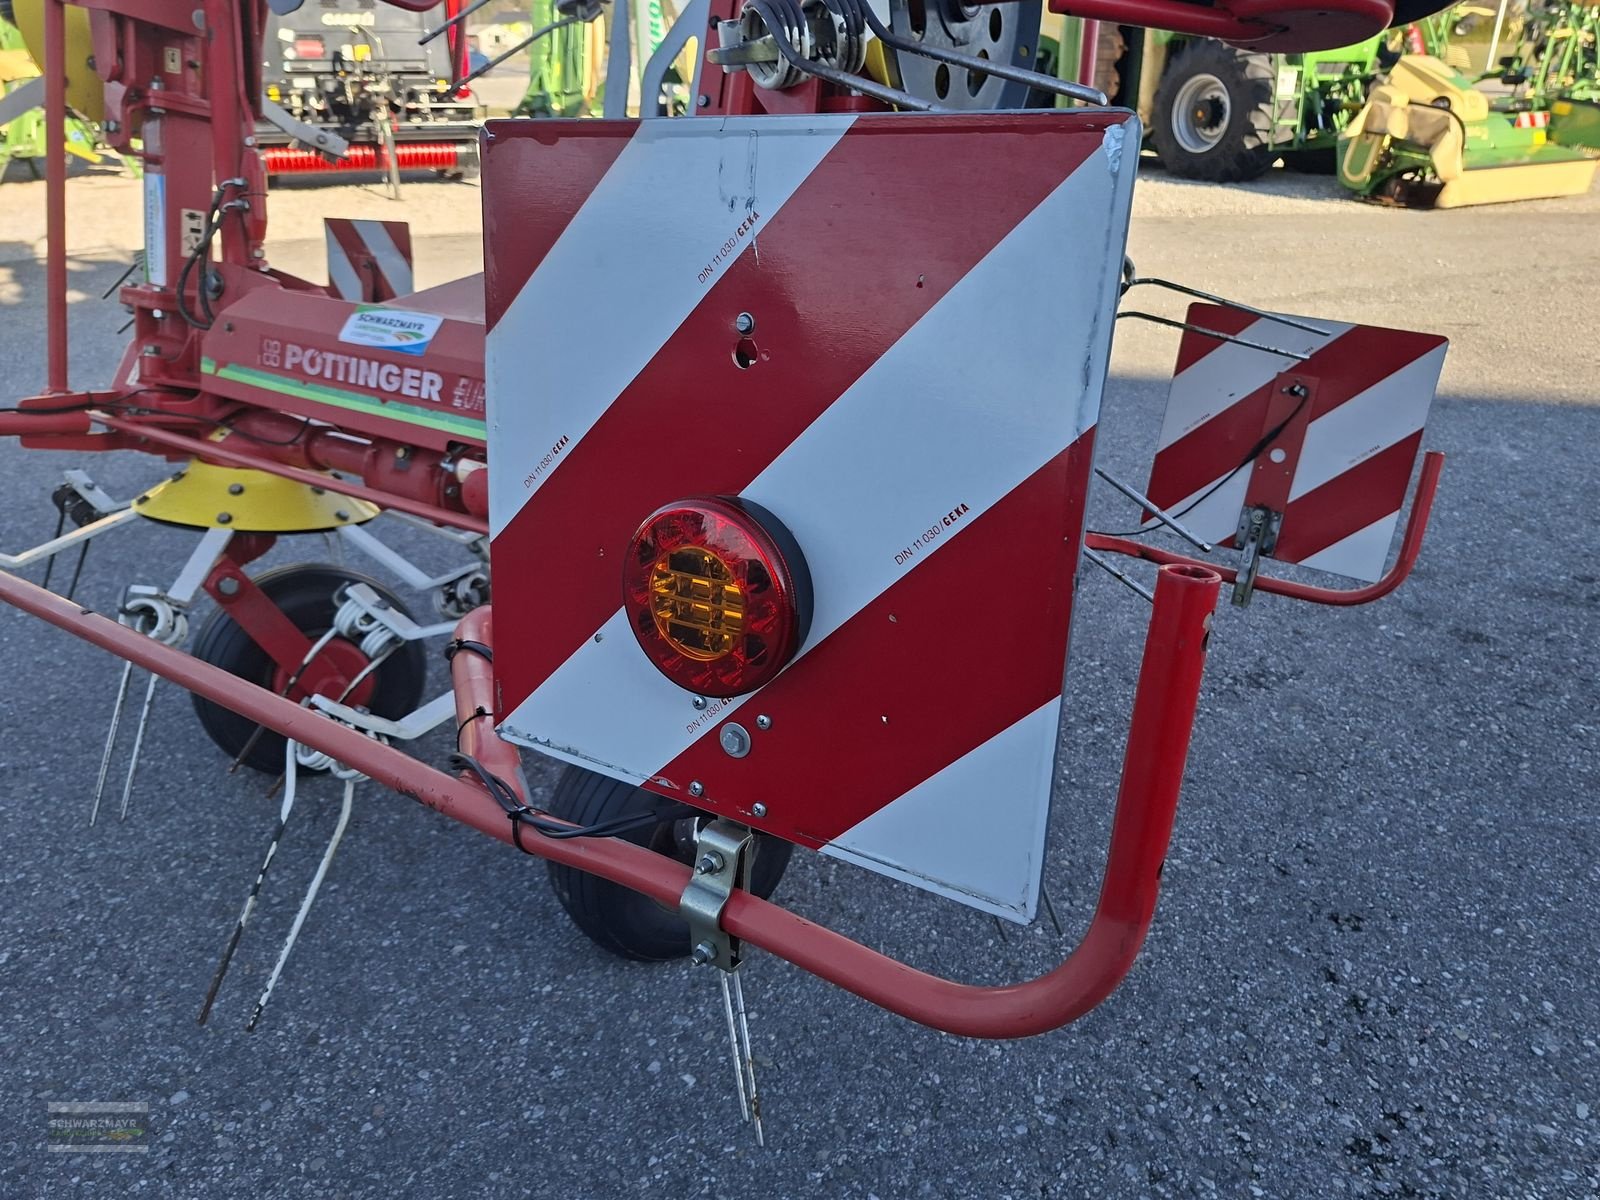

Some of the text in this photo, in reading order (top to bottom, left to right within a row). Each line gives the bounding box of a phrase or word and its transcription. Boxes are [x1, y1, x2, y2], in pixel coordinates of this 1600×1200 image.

[698, 264, 713, 284] DIN
[713, 254, 722, 265] 11
[358, 314, 424, 330] SCHWARZMAYR
[524, 473, 536, 488] DIN
[535, 467, 543, 475] 11
[894, 503, 970, 565] DIN 11 030/GEKA
[686, 697, 735, 734] DIN 11 030/G
